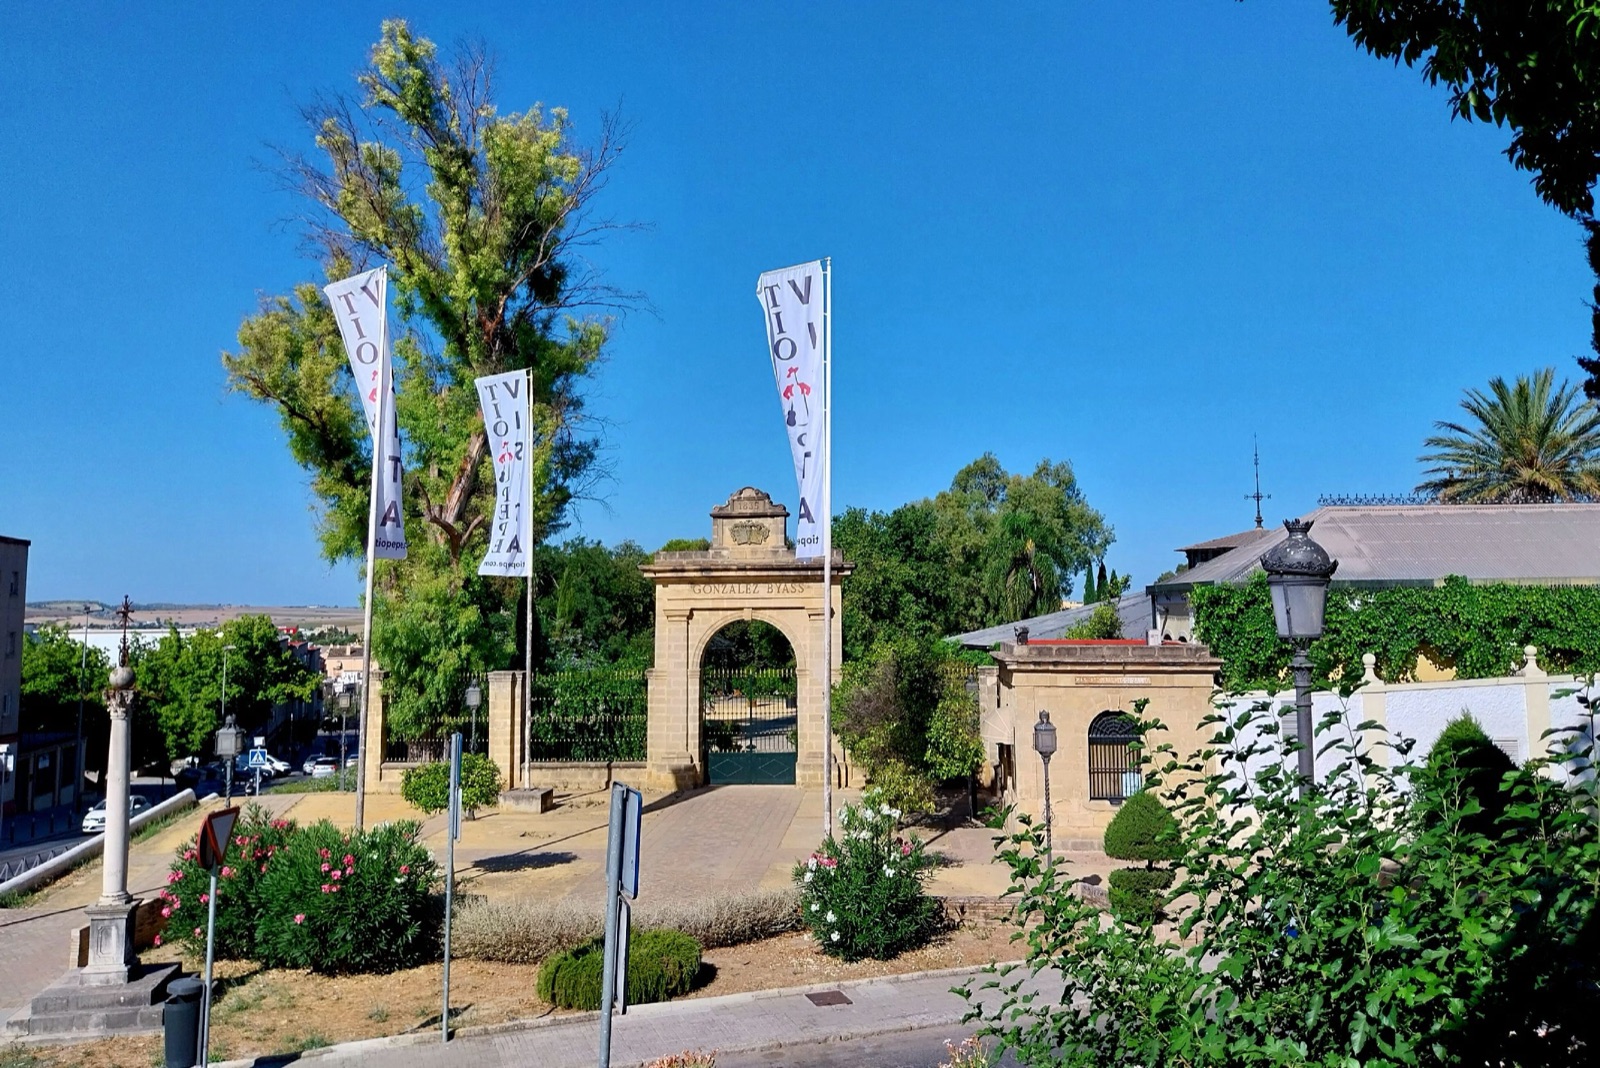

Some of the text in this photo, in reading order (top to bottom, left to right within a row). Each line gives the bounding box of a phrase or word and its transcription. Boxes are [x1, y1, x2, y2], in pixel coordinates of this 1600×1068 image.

[337, 290, 379, 366] TIO
[764, 282, 798, 361] TIO
[484, 384, 509, 437] TIO
[692, 582, 806, 595] GONZALEZ BYASS
